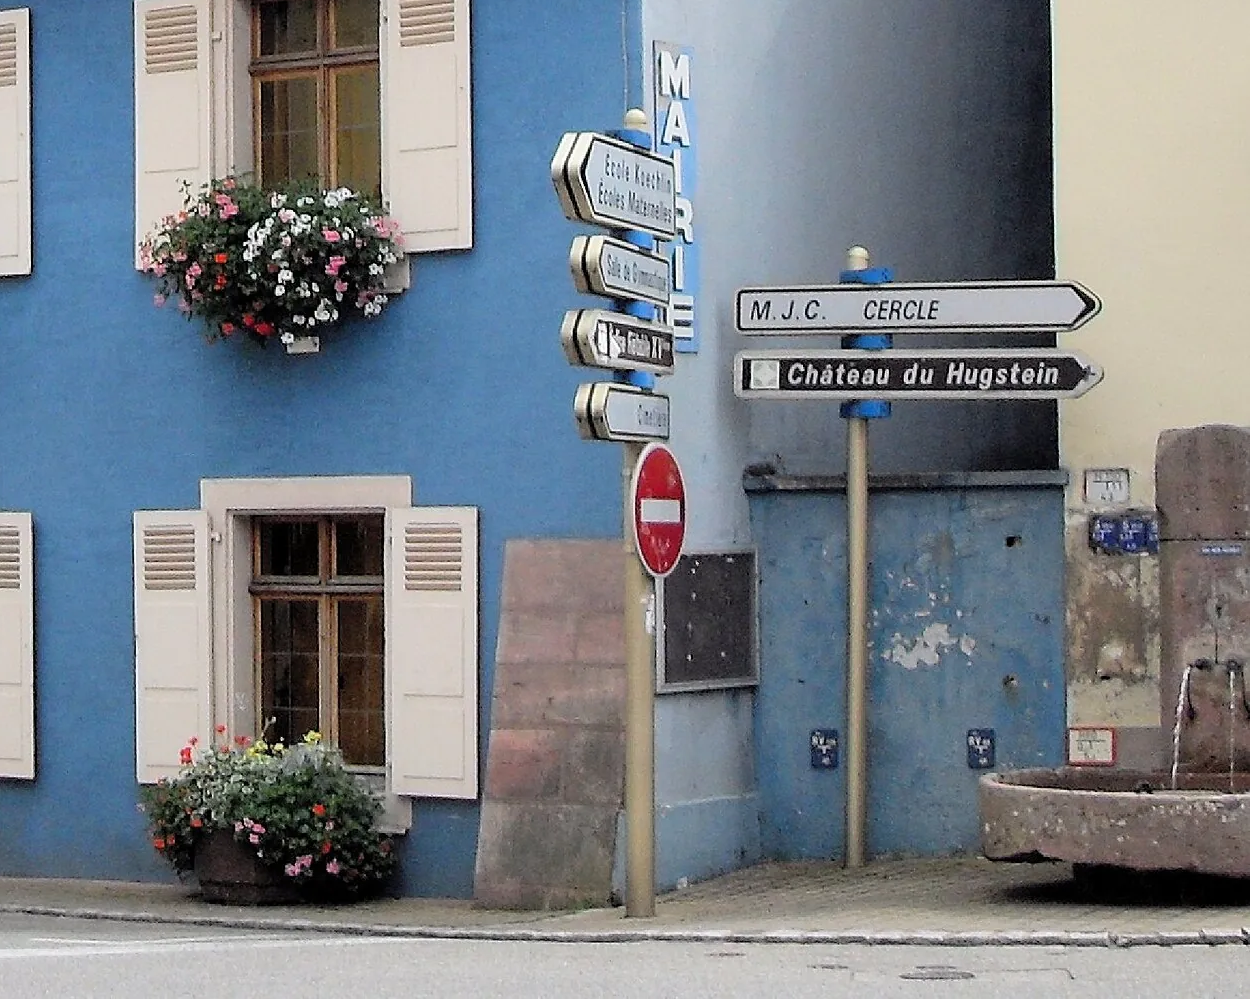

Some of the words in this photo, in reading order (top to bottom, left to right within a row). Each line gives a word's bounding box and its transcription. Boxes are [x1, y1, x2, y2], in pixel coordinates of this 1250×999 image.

[863, 299, 939, 321] CERCLE
[786, 361, 890, 385] Château
[903, 361, 933, 385] du
[946, 360, 1059, 391] Hugstein
